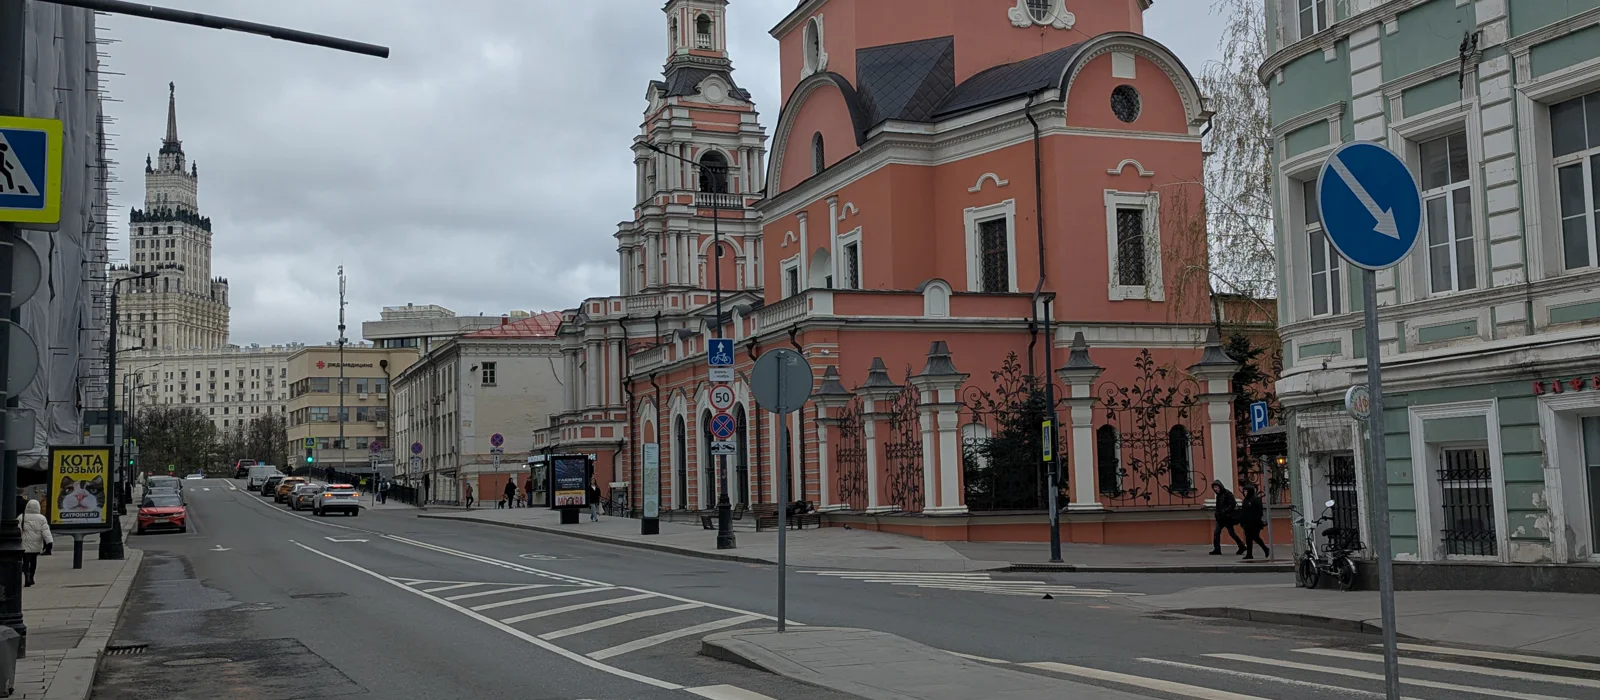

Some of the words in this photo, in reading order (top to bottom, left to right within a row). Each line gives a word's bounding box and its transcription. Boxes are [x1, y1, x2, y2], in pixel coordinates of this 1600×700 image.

[715, 392, 730, 403] 50
[1254, 405, 1264, 431] P
[60, 454, 103, 467] КОТА
[60, 466, 103, 474] ВОЗЬМИ
